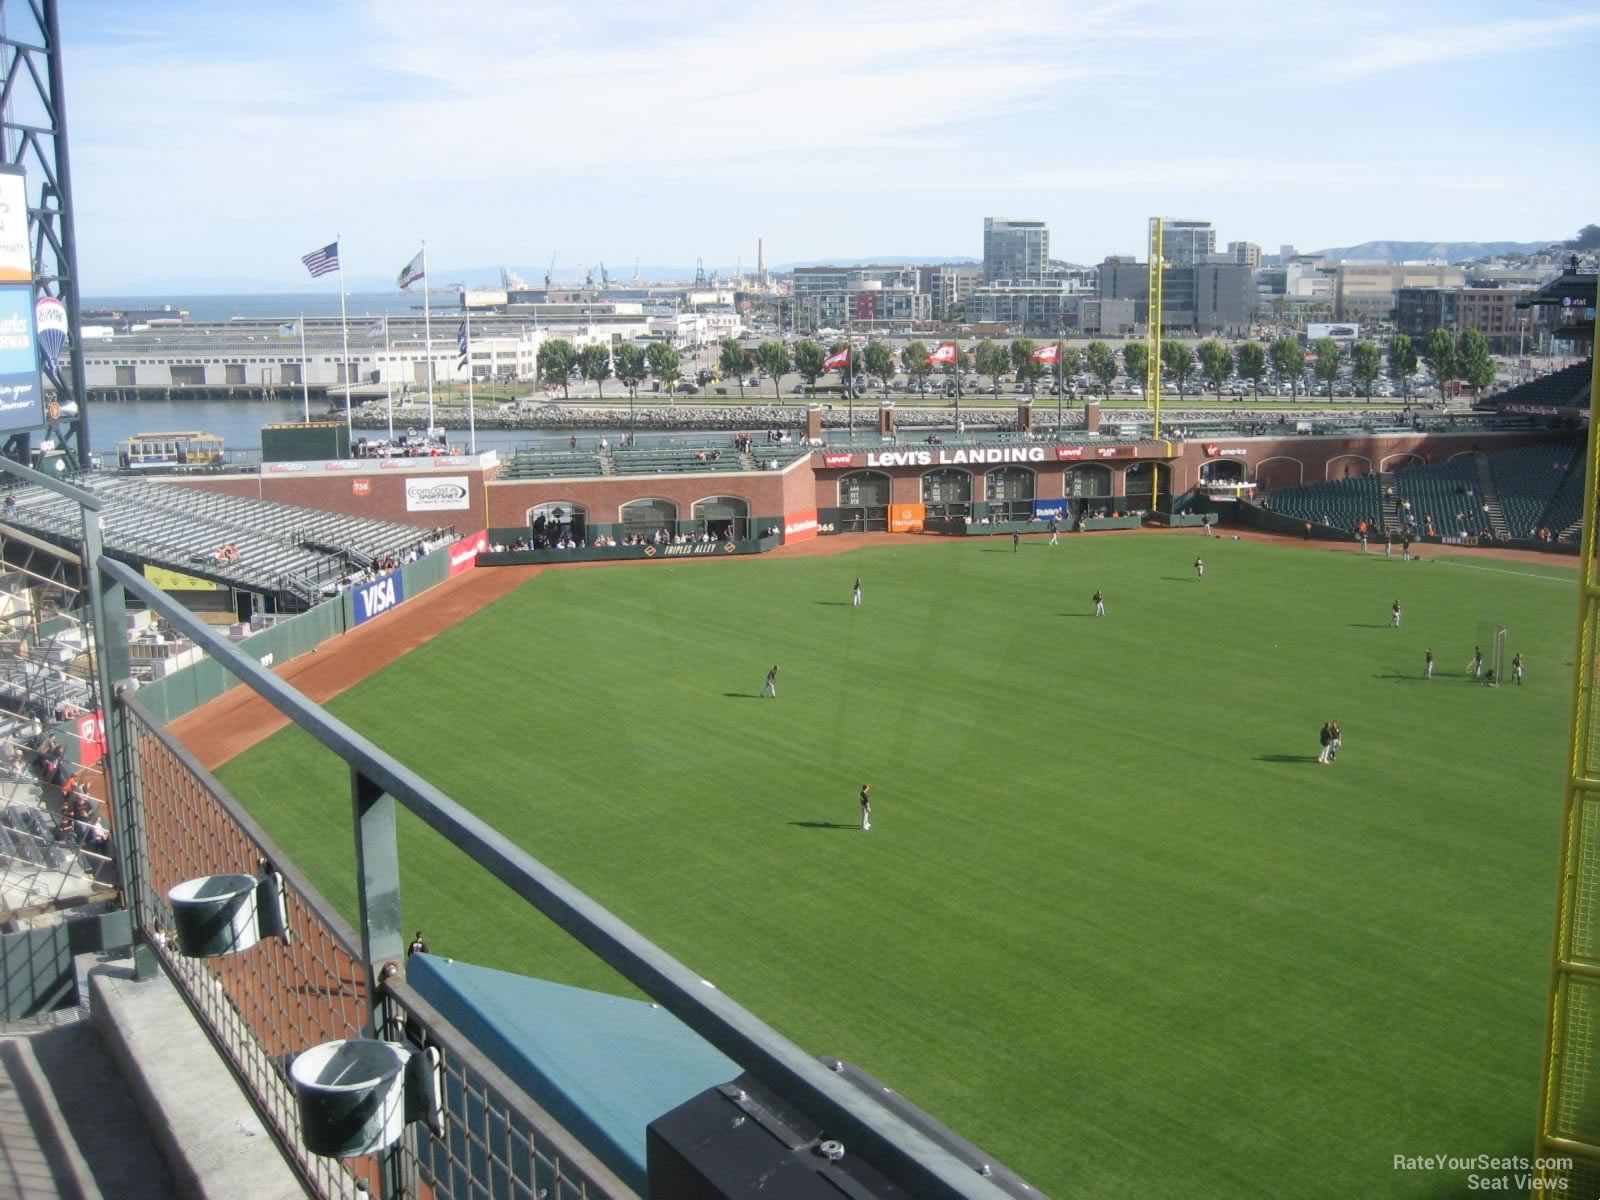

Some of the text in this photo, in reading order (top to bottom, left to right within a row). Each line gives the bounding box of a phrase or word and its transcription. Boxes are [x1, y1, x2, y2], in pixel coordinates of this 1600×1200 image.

[939, 447, 1044, 465] LANDING
[817, 523, 834, 532] 365
[664, 544, 716, 555] TRIPLES ALLEY
[360, 577, 396, 617] VISA
